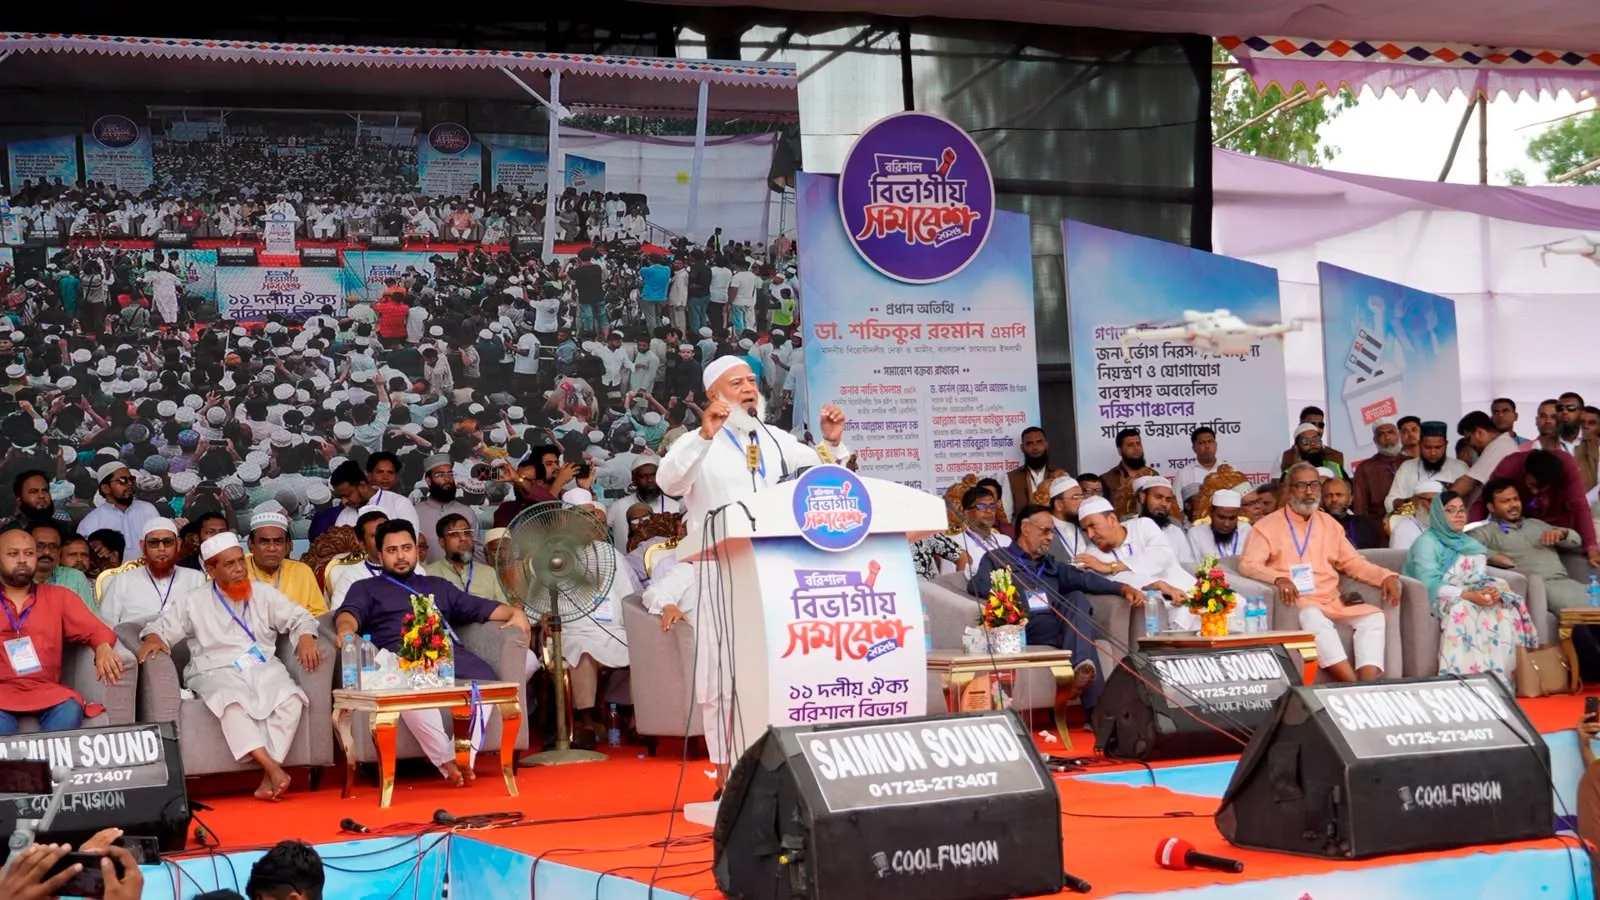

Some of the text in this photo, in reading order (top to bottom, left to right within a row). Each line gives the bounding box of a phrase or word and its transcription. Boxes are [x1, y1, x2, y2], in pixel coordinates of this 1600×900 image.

[885, 160, 922, 173] বরিশাল
[870, 174, 966, 206] বিভাগীয়
[857, 204, 980, 244] সমাবেশ
[229, 294, 250, 305] ১১
[886, 301, 954, 315] প্রধান অতিথি
[814, 318, 1026, 345] ডা. শফিকুর রহমান এমপি
[883, 366, 912, 376] সমাবেশে
[914, 366, 933, 376] বক্তব্য
[1097, 363, 1220, 381] নিয়ন্ত্রণ ও যোগাযোগ
[1098, 380, 1217, 400] ব্যবস্থাসহ অবহেলিত
[1099, 400, 1195, 419] দক্ষিণাঞ্চলের
[1145, 420, 1196, 438] উন্নয়নের
[1200, 418, 1241, 435] াবিতে
[808, 495, 857, 511] বিভাগীয়
[804, 572, 847, 587] বরিশাল
[790, 585, 897, 620] বিভাগীয়
[781, 618, 914, 661] সমাবেশ
[1155, 652, 1281, 686] SAIMUN SOUND
[789, 677, 909, 700] ১১ দলীয় ঐক্য
[788, 699, 908, 723] বরিশাল বিভাগ
[1327, 685, 1509, 731] SAIMUN SOUND
[1386, 728, 1494, 747] 01725-273407
[78, 730, 159, 768] SOUND
[810, 723, 1020, 780] SAIMUN SOUND
[52, 769, 133, 787] -273407
[869, 772, 998, 797] 01725-273407
[31, 791, 126, 812] COLFUSION
